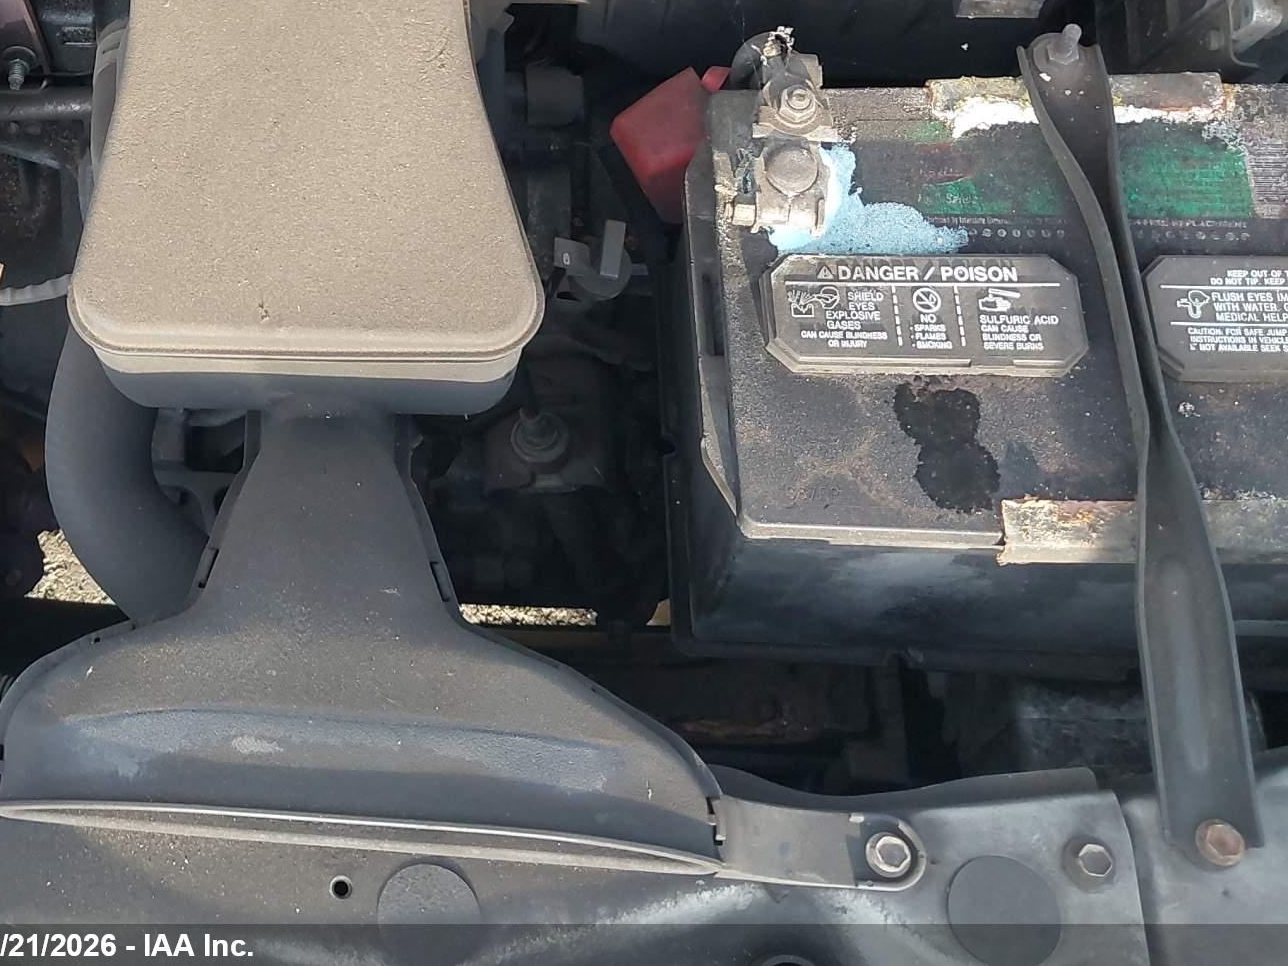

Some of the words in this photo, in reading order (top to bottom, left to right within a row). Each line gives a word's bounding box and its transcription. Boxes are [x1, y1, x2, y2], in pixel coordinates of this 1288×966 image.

[838, 265, 920, 281] DANGER
[940, 266, 1018, 282] POISON
[1210, 277, 1223, 285] DO
[1225, 277, 1242, 285] NOT
[1264, 277, 1286, 285] KEEP
[847, 292, 884, 301] SHIELD
[1212, 292, 1245, 302] FLUSH
[1247, 292, 1273, 302] EYES
[848, 301, 875, 311] EYES
[1213, 302, 1240, 312] WITH
[825, 311, 881, 321] EXPLOSIVE
[919, 314, 937, 323] NO
[979, 315, 1031, 325] SULFURIC
[1033, 315, 1059, 325] ACID
[1215, 312, 1260, 322] MEDICAL
[1262, 312, 1288, 322] HELP
[827, 320, 861, 329] GASES
[914, 324, 946, 332] SPARKS
[980, 324, 999, 333] CAN
[1000, 325, 1030, 334] CAUSE
[800, 330, 817, 338] CAN
[818, 331, 844, 339] CAUSE
[845, 331, 888, 340] BLINDNESS
[1225, 327, 1242, 336] FOR
[1243, 328, 1264, 336] SAFE
[1266, 328, 1288, 336] JUMP
[915, 332, 947, 341] FLAMES
[982, 333, 1028, 342] BLINDNESS
[1028, 333, 1042, 342] OR
[1247, 336, 1258, 344] IN
[827, 339, 840, 348] OR
[840, 340, 868, 348] INJURY
[916, 341, 953, 350] SMOKING
[983, 342, 1015, 351] SEVERE
[1016, 342, 1044, 351] BURNS
[1199, 343, 1216, 351] NOT
[1218, 344, 1259, 352] AVAILABLE
[1260, 344, 1282, 352] SEEK
